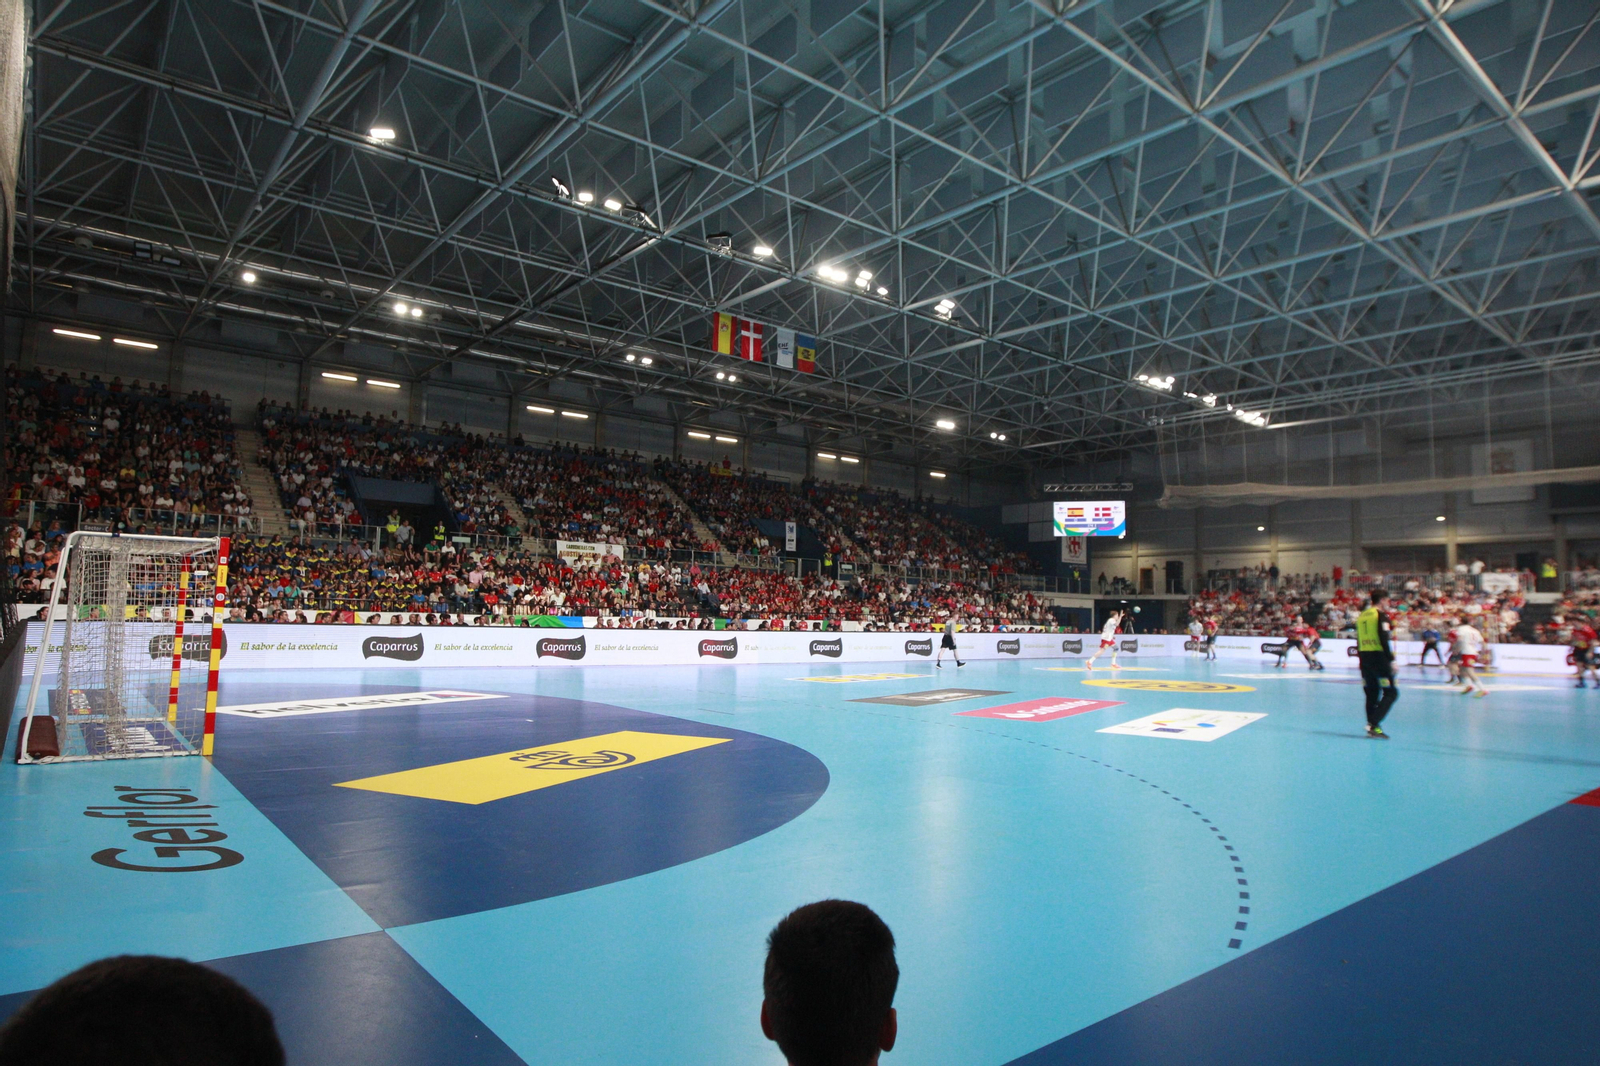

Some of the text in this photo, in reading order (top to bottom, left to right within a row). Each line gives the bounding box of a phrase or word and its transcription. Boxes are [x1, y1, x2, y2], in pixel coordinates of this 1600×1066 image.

[1363, 620, 1368, 634] 1
[240, 642, 338, 651] El sabor de la excelencia
[434, 643, 513, 651] El sabor de la excelencia
[83, 785, 245, 872] Gerflor
